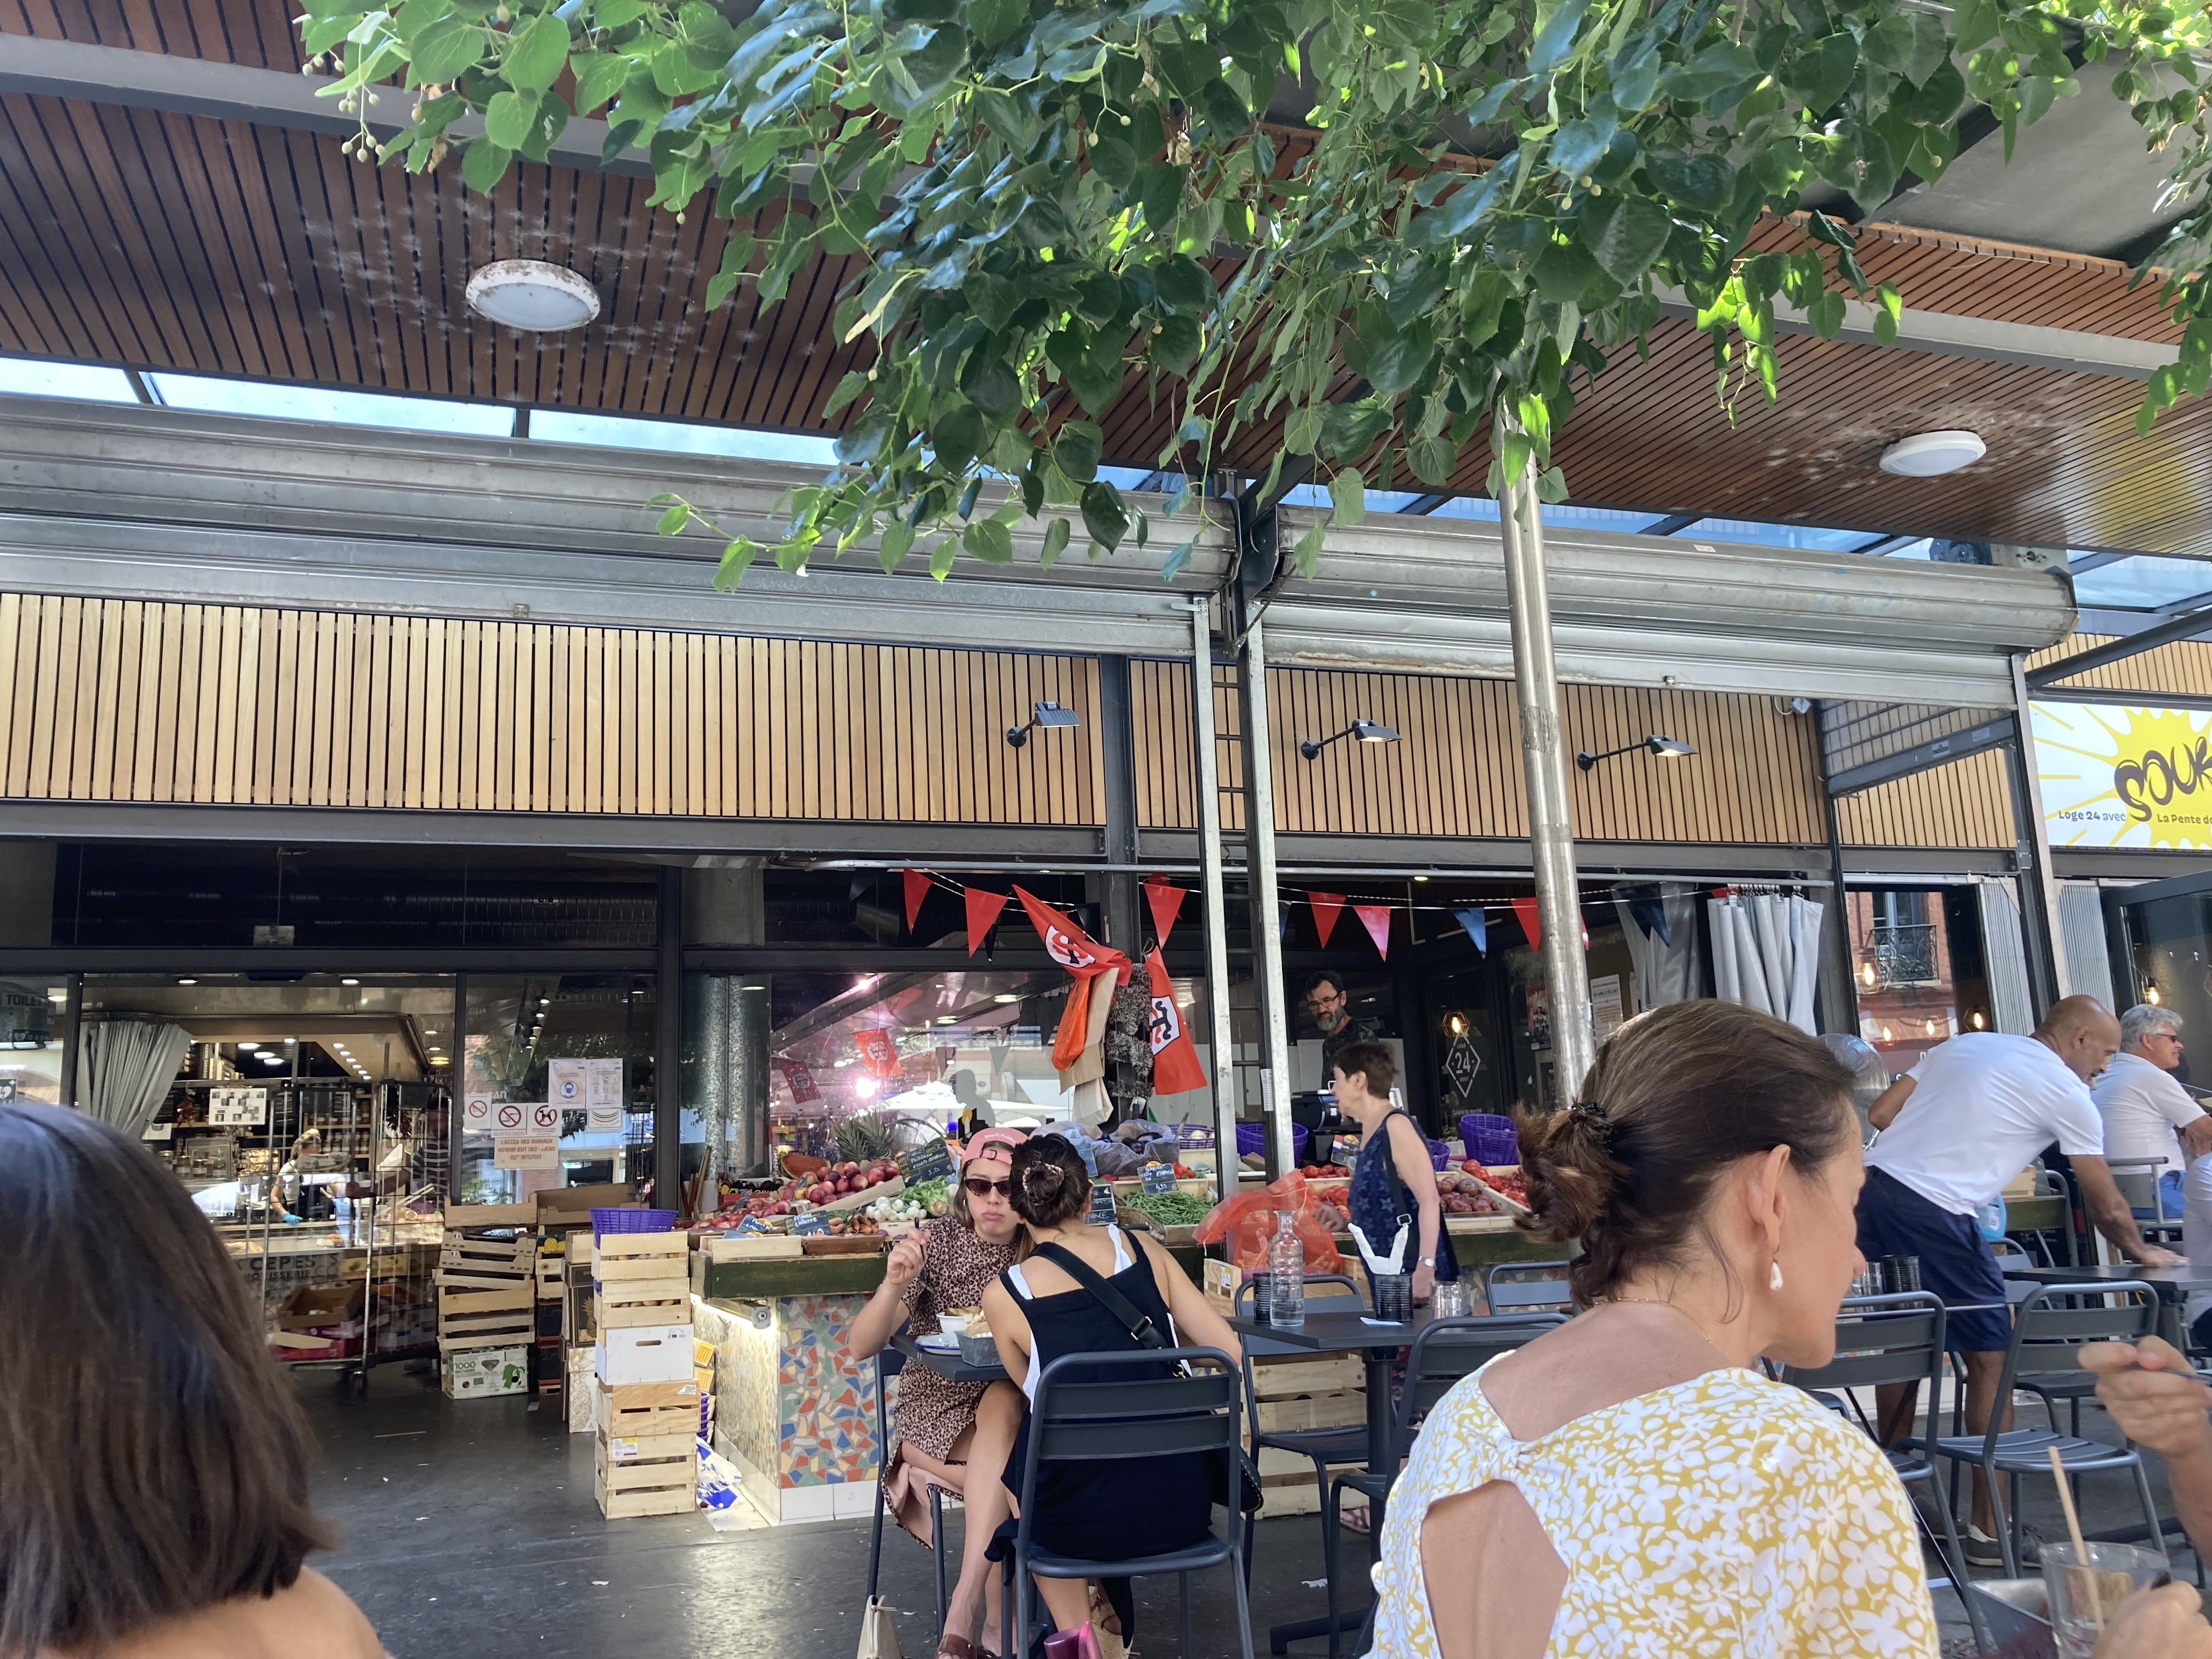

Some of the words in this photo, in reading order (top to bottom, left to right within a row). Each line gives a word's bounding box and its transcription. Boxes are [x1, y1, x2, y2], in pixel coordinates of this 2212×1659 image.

[2058, 810, 2084, 822] Loge
[2086, 811, 2100, 820] 24
[2103, 812, 2126, 821] avec
[2157, 814, 2169, 822] La
[2171, 814, 2201, 823] Pente
[1455, 1051, 1471, 1074] 24
[454, 1361, 476, 1370] 1000
